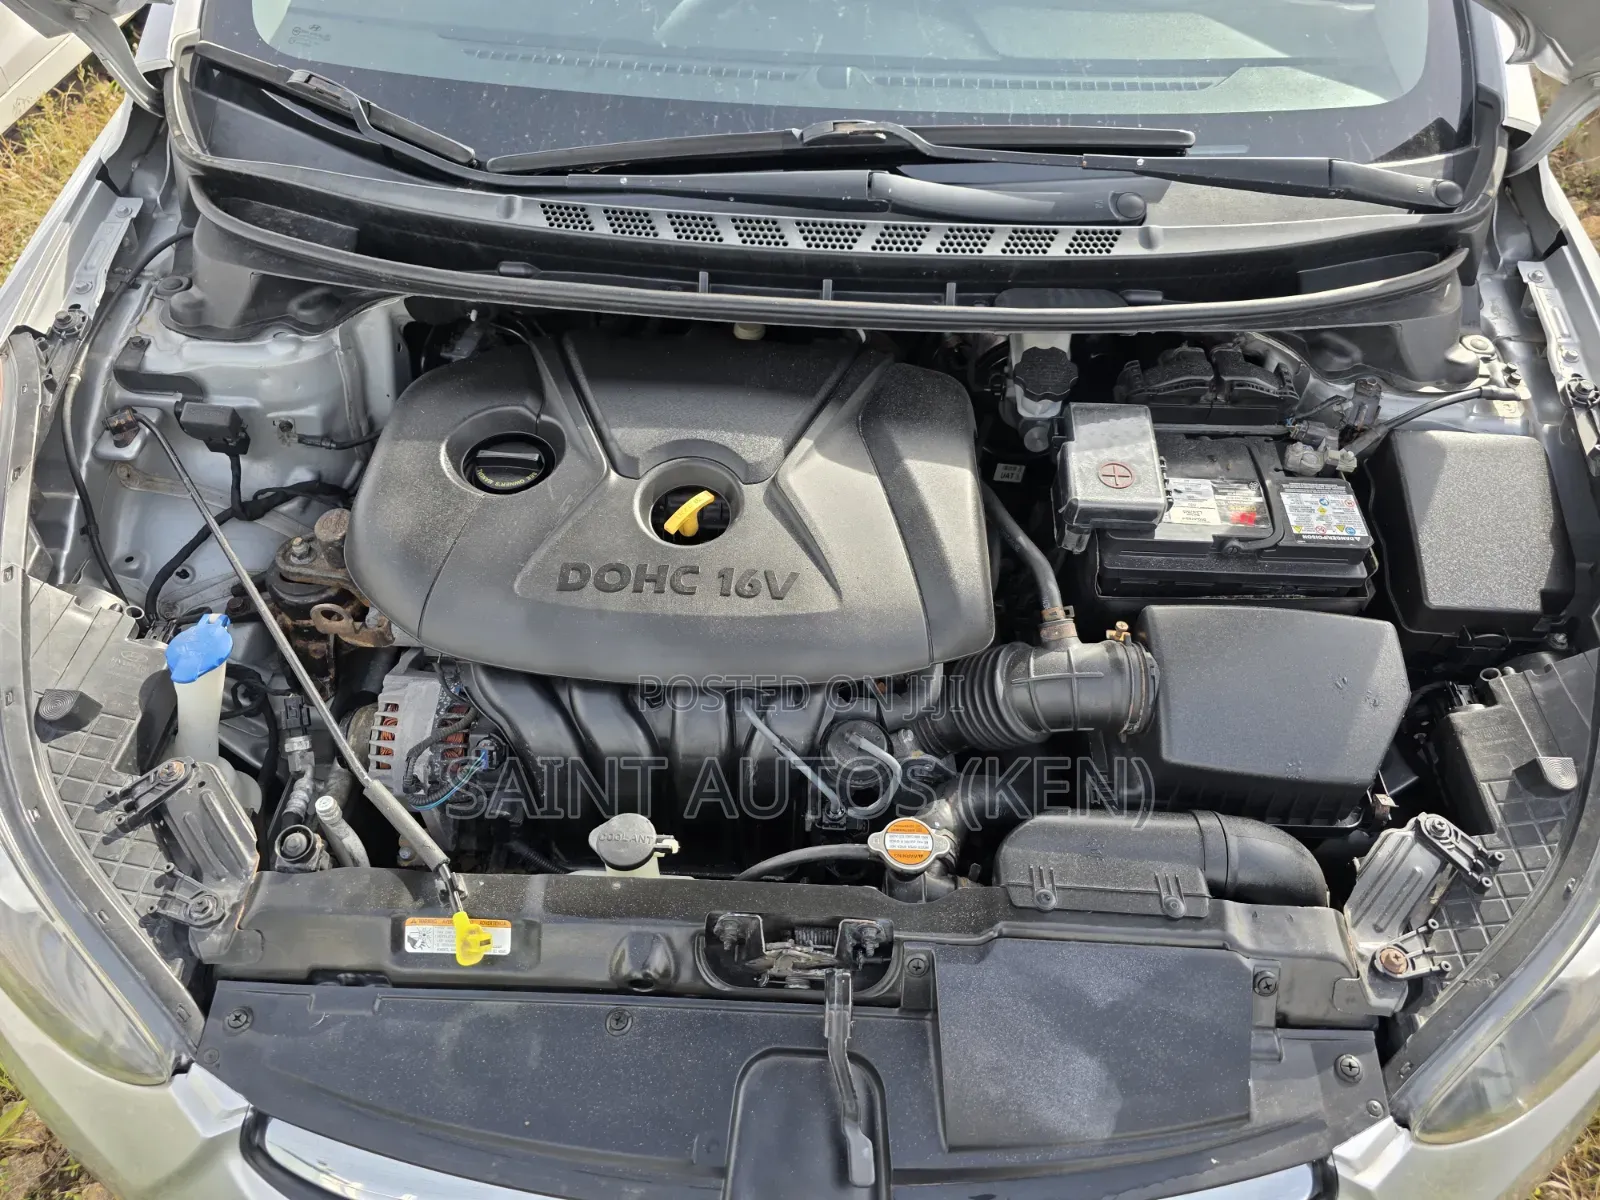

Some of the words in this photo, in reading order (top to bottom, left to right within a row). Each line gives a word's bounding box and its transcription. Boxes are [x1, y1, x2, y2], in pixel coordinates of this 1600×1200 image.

[526, 472, 538, 480] SEE
[495, 479, 525, 487] OWNER'S
[556, 562, 701, 596] DOHC
[717, 567, 800, 601] 16V
[598, 833, 653, 845] COOLANT
